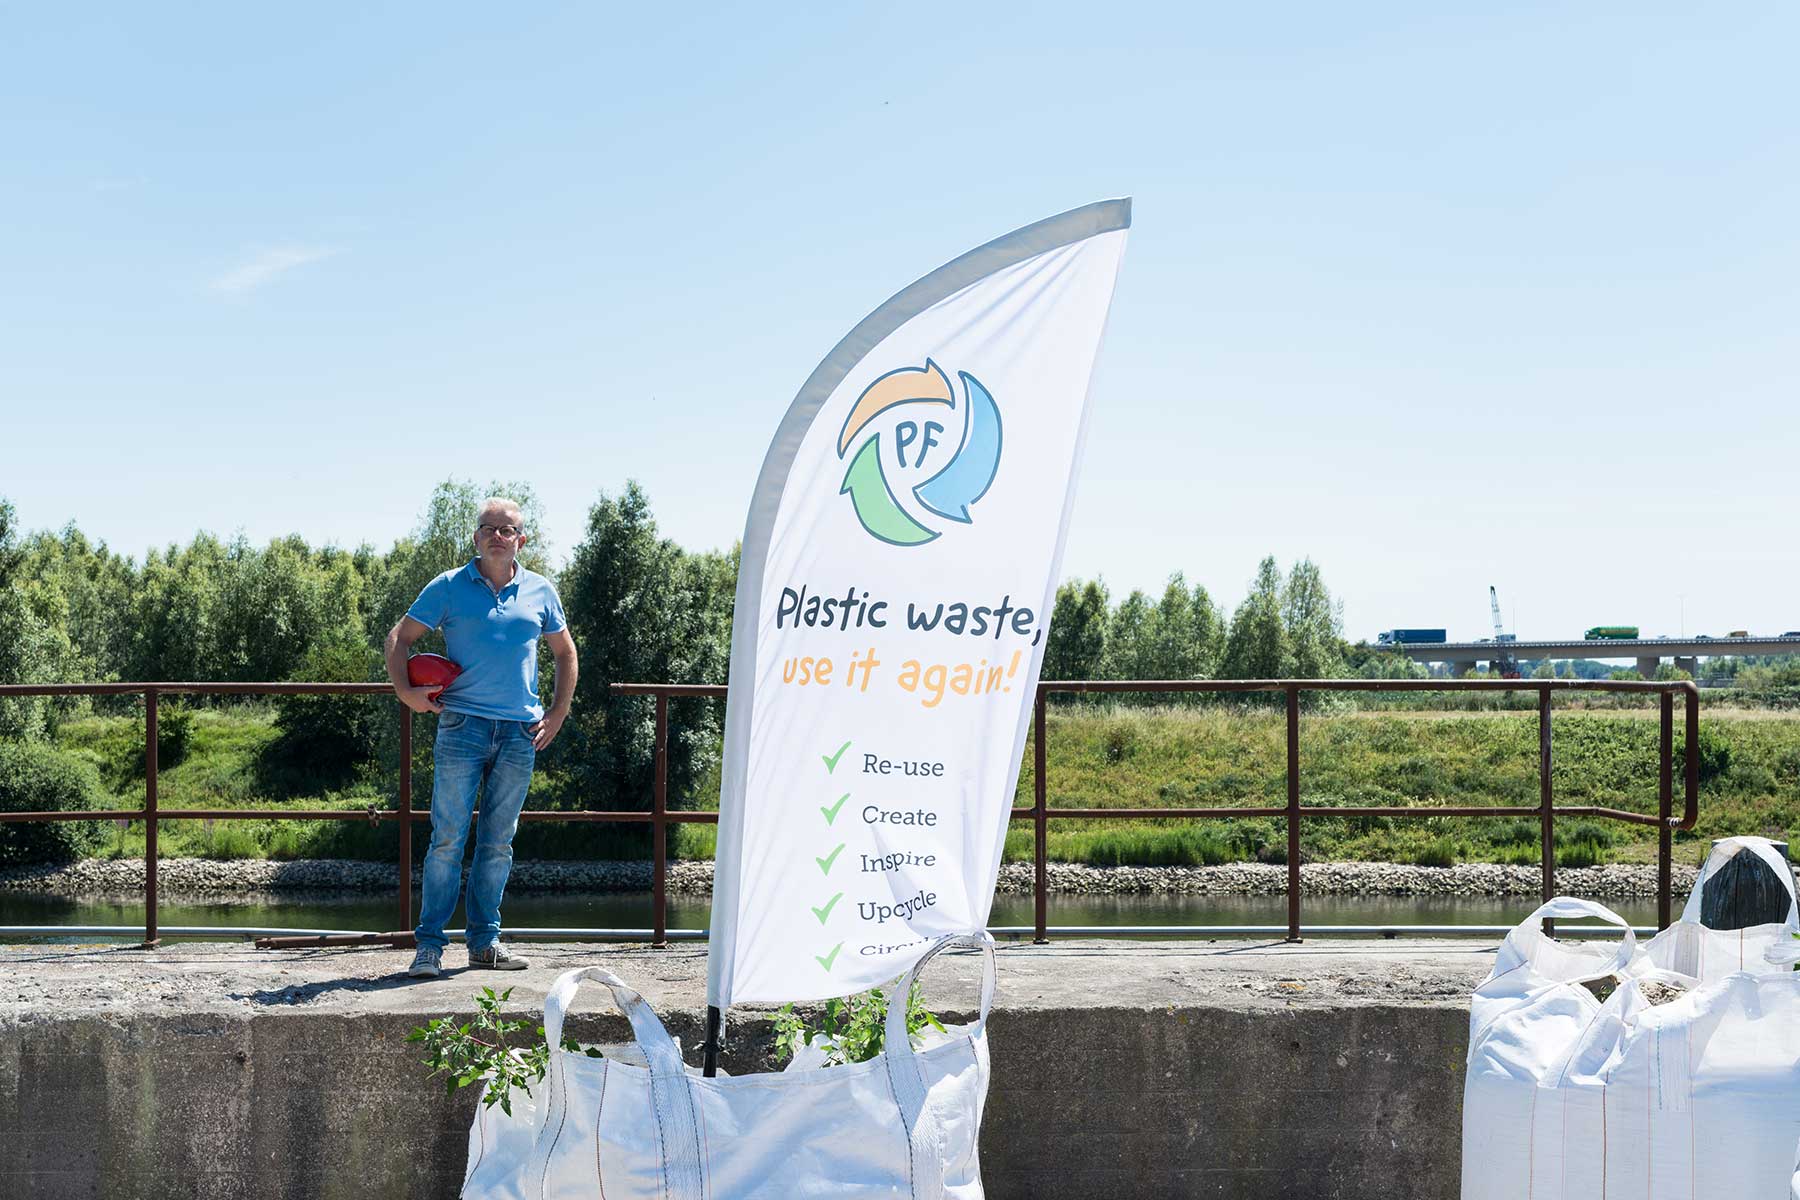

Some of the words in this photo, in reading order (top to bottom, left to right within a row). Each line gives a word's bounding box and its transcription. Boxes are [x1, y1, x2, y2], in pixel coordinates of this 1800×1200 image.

[895, 420, 945, 469] PF
[776, 585, 888, 632] Plastic
[906, 595, 1042, 647] waste,
[783, 656, 834, 687] use
[846, 647, 881, 693] it
[897, 649, 1022, 708] again!
[862, 753, 945, 777] Re-use
[862, 805, 937, 827] Create
[860, 851, 936, 872] Inspire
[857, 890, 937, 924] Upcycle
